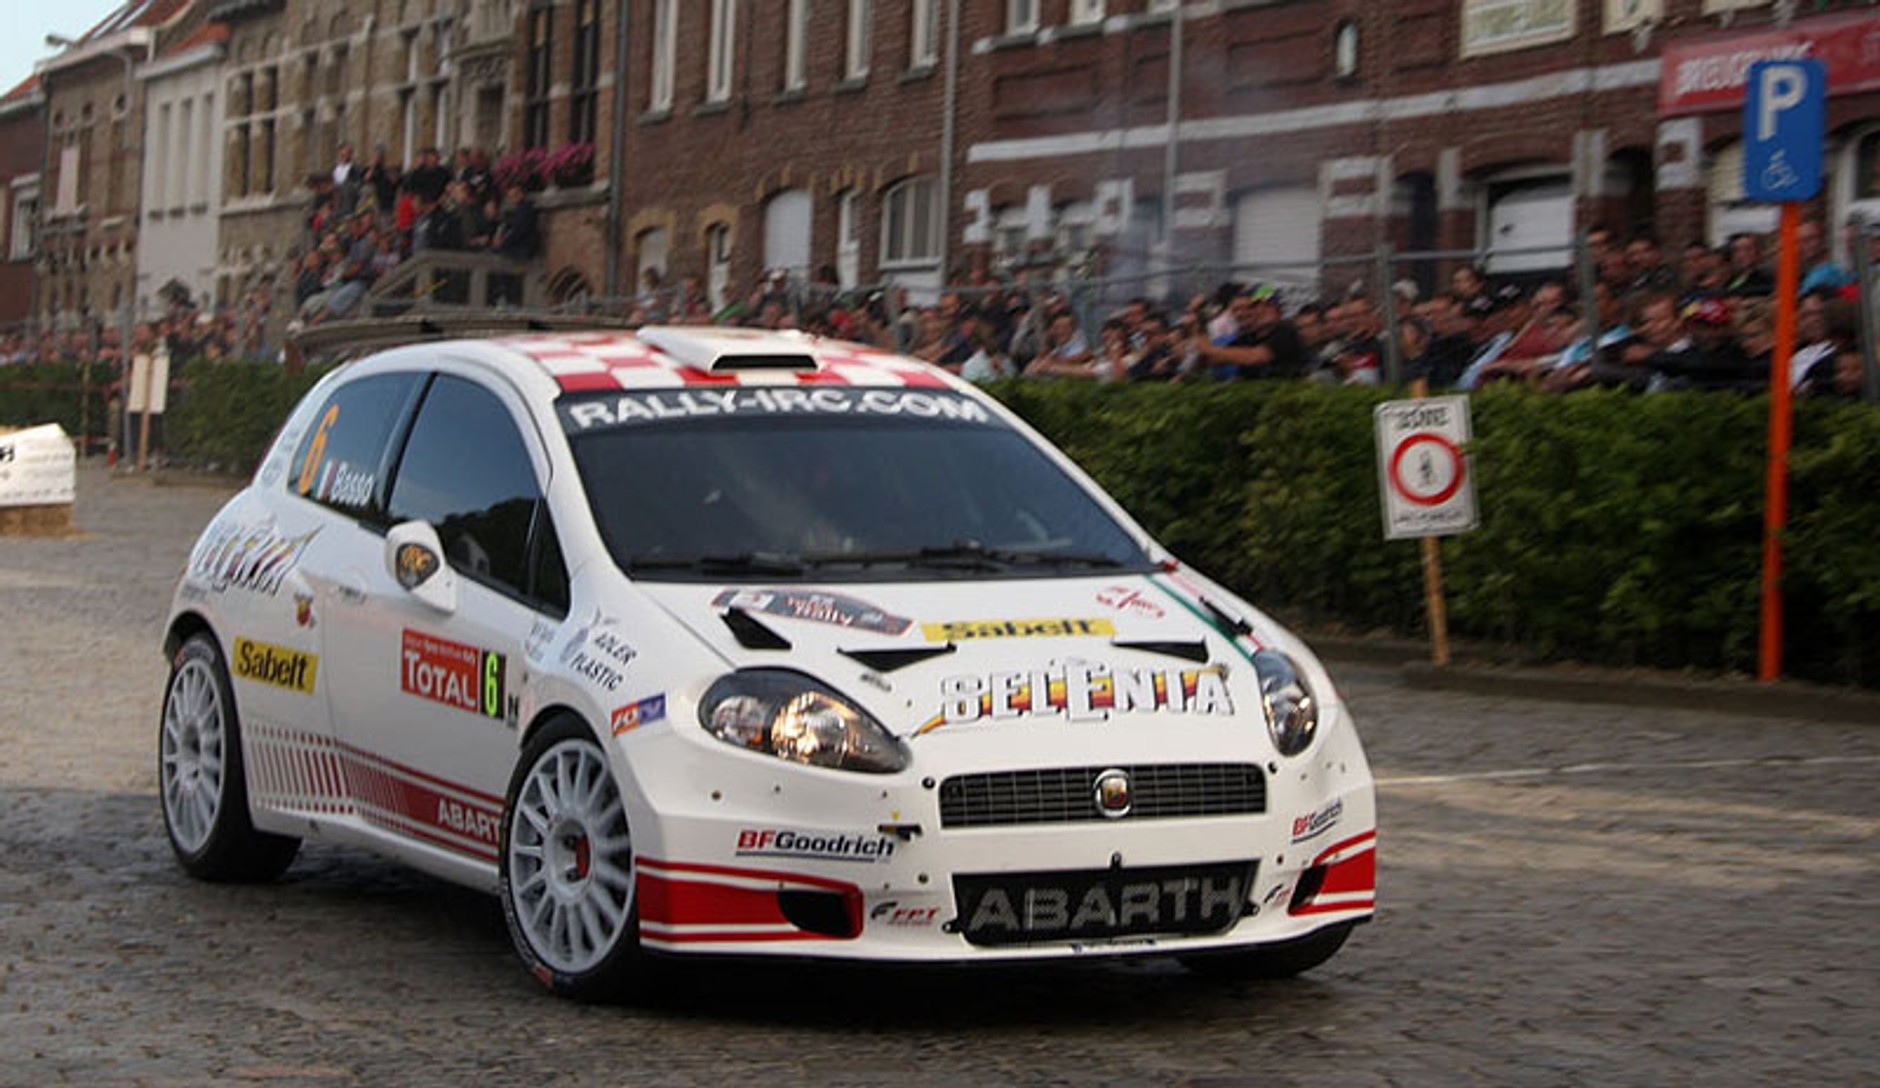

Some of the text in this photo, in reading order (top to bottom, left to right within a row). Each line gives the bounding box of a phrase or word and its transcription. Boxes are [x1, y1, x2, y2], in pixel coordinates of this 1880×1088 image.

[1757, 65, 1807, 141] P
[569, 389, 989, 430] RALLY-IRC.COM
[299, 403, 339, 495] 6
[942, 619, 1095, 639] Sabelt
[238, 641, 308, 688] Sabelt
[404, 650, 498, 717] TOTAL 6
[569, 652, 623, 691] PLASTIC
[437, 799, 501, 844] ABART
[737, 829, 894, 857] BFGoodrich
[968, 876, 1242, 930] ABARTH
